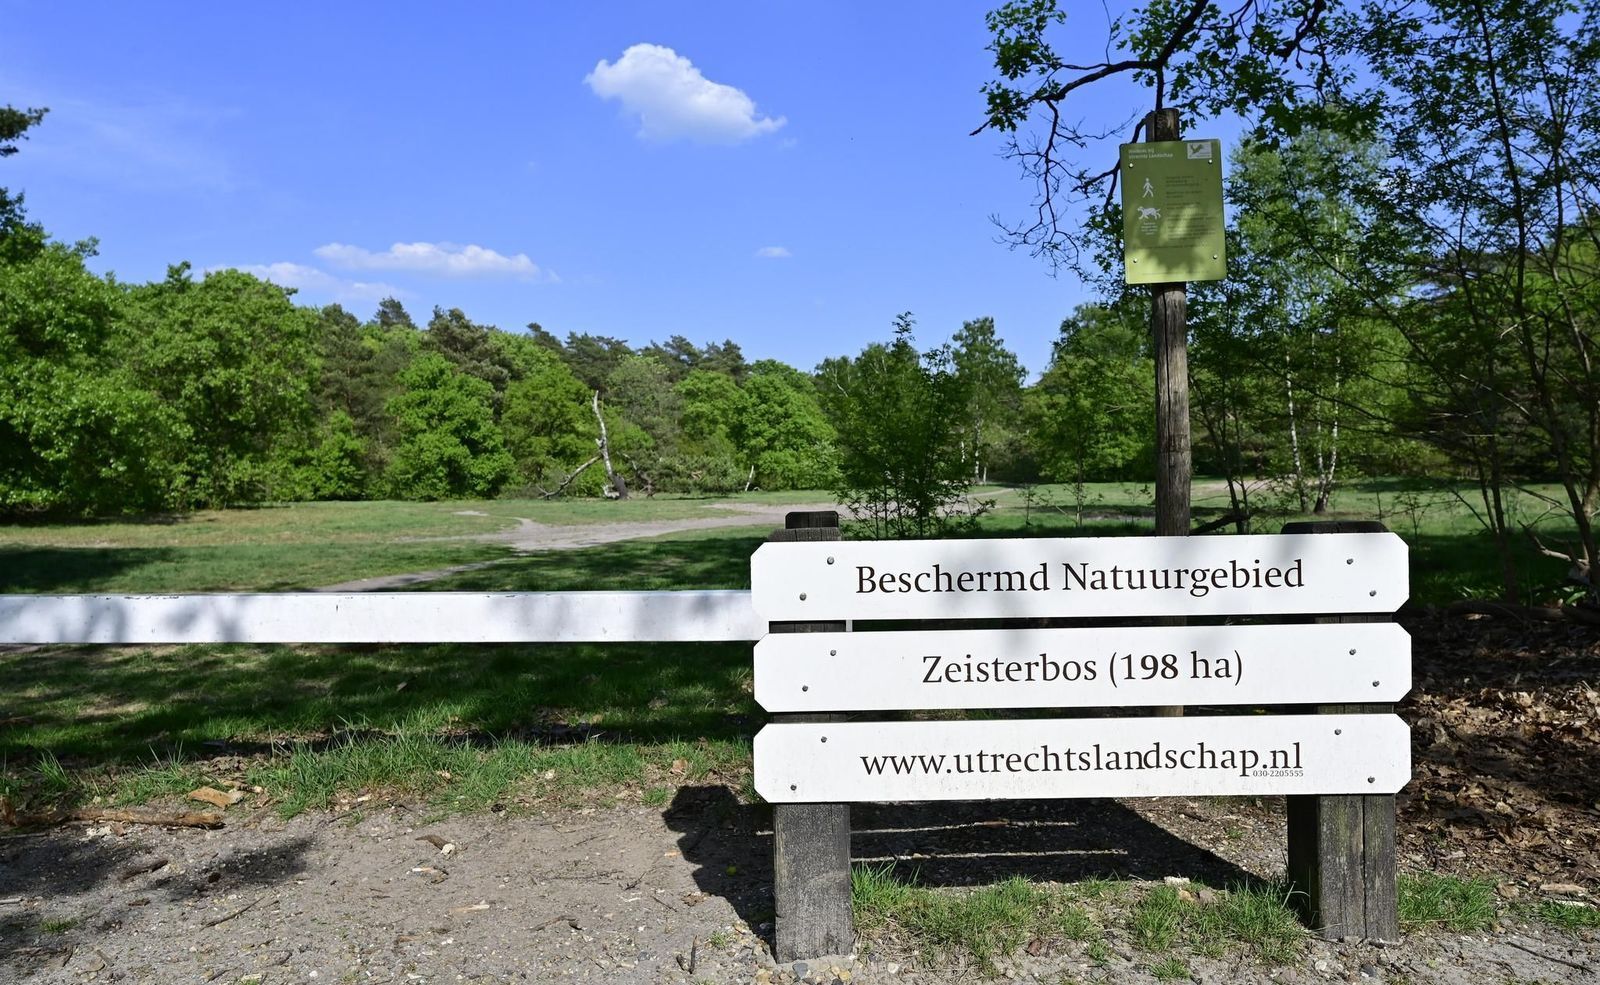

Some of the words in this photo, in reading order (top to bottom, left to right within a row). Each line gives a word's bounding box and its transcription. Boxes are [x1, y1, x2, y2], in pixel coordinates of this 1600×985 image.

[856, 562, 1050, 594] Beschermd
[1063, 559, 1305, 597] Natuurgebied
[923, 653, 1097, 683] Zeisterbos
[1110, 652, 1178, 687] (198
[1191, 650, 1242, 686] ha)
[860, 741, 1303, 777] www.utrechtslandschap.nl
